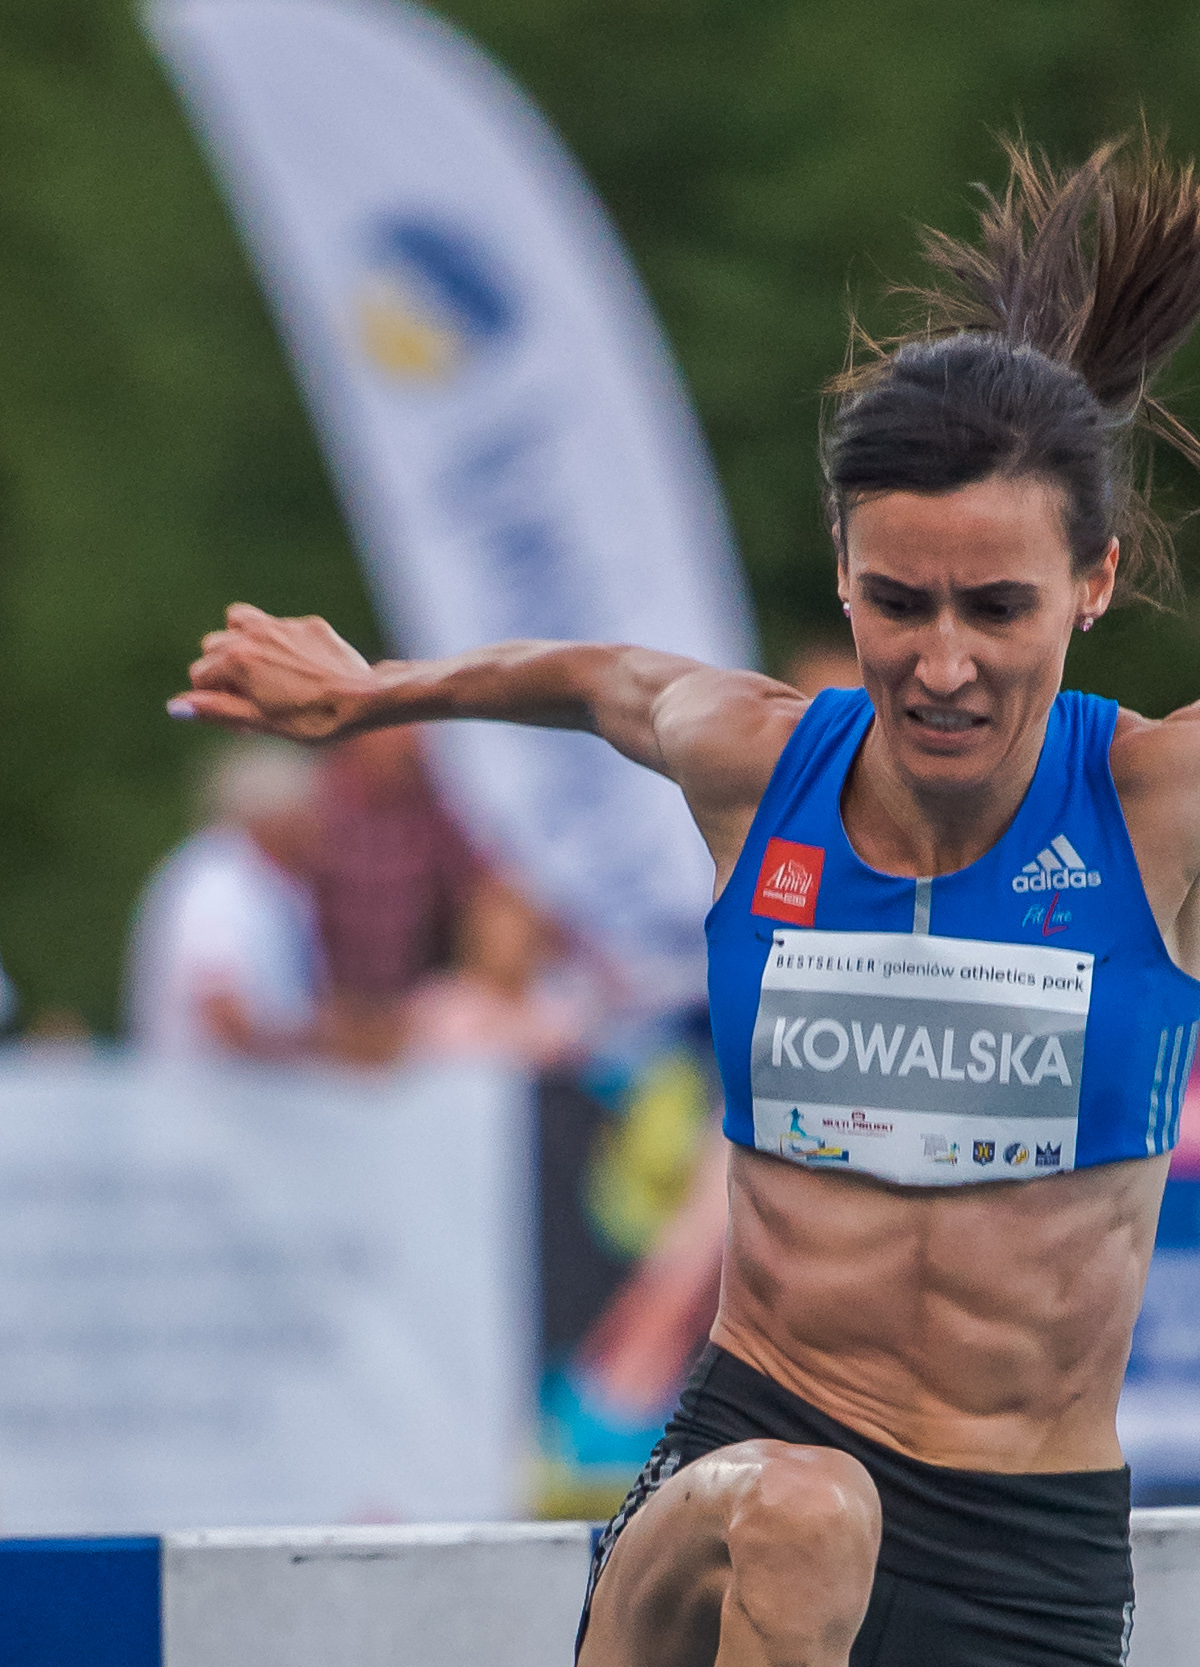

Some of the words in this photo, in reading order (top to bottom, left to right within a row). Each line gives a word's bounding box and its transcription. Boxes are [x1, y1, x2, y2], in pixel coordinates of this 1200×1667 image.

[1012, 868, 1101, 893] adidas
[776, 953, 875, 972] BESTSELLER
[882, 959, 955, 979] goleniów
[960, 963, 1036, 987] athletics
[1042, 975, 1085, 993] park
[771, 1016, 1073, 1087] KOWALSKA
